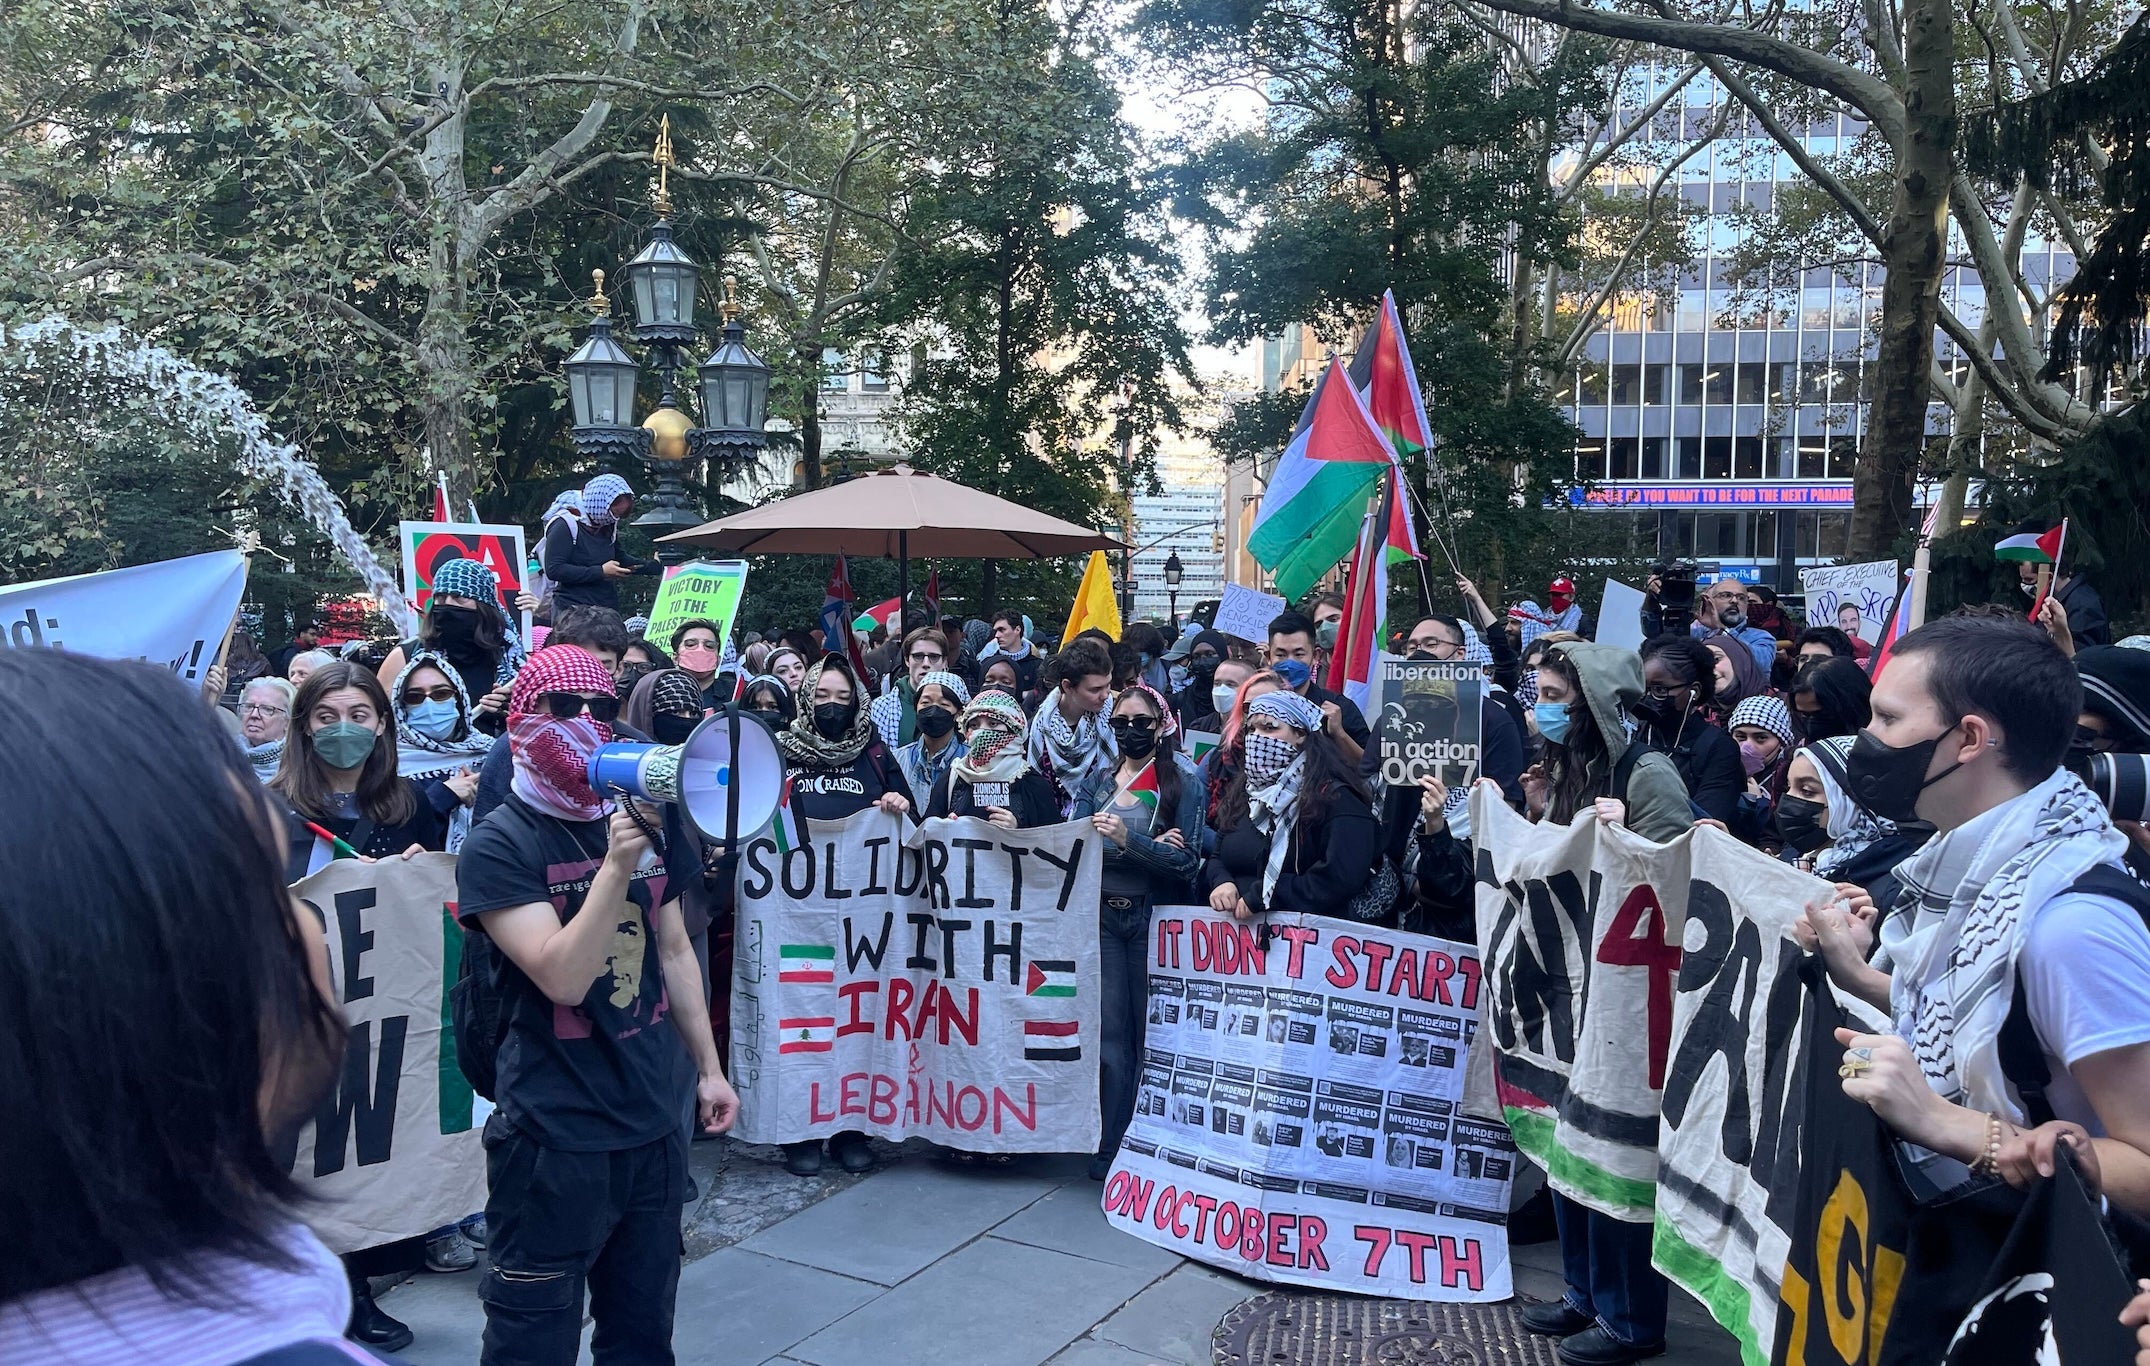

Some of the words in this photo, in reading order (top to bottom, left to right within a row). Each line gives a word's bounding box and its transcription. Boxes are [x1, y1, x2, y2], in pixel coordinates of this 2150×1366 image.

[1643, 488, 1665, 503] YOU
[1667, 488, 1700, 503] WANT
[1702, 488, 1716, 502] TO
[1718, 488, 1733, 502] BE
[1734, 488, 1756, 502] FOR
[1758, 488, 1779, 502] THE
[1781, 488, 1808, 502] NEXT
[1810, 488, 1854, 502] PARADE
[1806, 569, 1840, 589] CHIEF
[1843, 560, 1897, 582] EXECUTIVE
[668, 577, 722, 597] VICTORY
[1837, 580, 1848, 589] OF
[1849, 579, 1863, 589] THE
[669, 600, 682, 614] TO
[683, 598, 708, 614] THE
[1223, 584, 1253, 613] 78
[1223, 621, 1245, 634] NOT
[1246, 628, 1257, 639] 3
[1384, 661, 1481, 681] liberation
[1380, 736, 1400, 758] in
[1404, 738, 1479, 761] action
[1382, 757, 1450, 786] OCT
[1457, 759, 1477, 788] 7
[824, 777, 864, 795] RAISED
[972, 782, 1001, 795] ZIONISM
[1001, 782, 1010, 795] IS
[972, 794, 1010, 808] TERRORISM
[843, 911, 1022, 986] WITH
[1157, 919, 1184, 969] IT
[1191, 919, 1319, 980] DIDN'T
[1325, 935, 1482, 1010] START
[1268, 991, 1320, 1007] MURDERED
[836, 978, 979, 1046] IRAN
[1331, 1001, 1390, 1020] MURDERED
[1401, 1012, 1459, 1031] MURDERED
[1175, 1075, 1209, 1089] MURDERED
[1214, 1082, 1251, 1098] MURDERED
[809, 1072, 1037, 1134] LEBANON
[1256, 1091, 1308, 1109] MURDERED
[1318, 1101, 1378, 1119] MURDERED
[1388, 1113, 1447, 1131] MURDERED
[1456, 1124, 1514, 1142] MURDERED
[1104, 1169, 1154, 1223] ON
[1153, 1184, 1330, 1272] OCTOBER
[1354, 1225, 1484, 1292] 7TH
